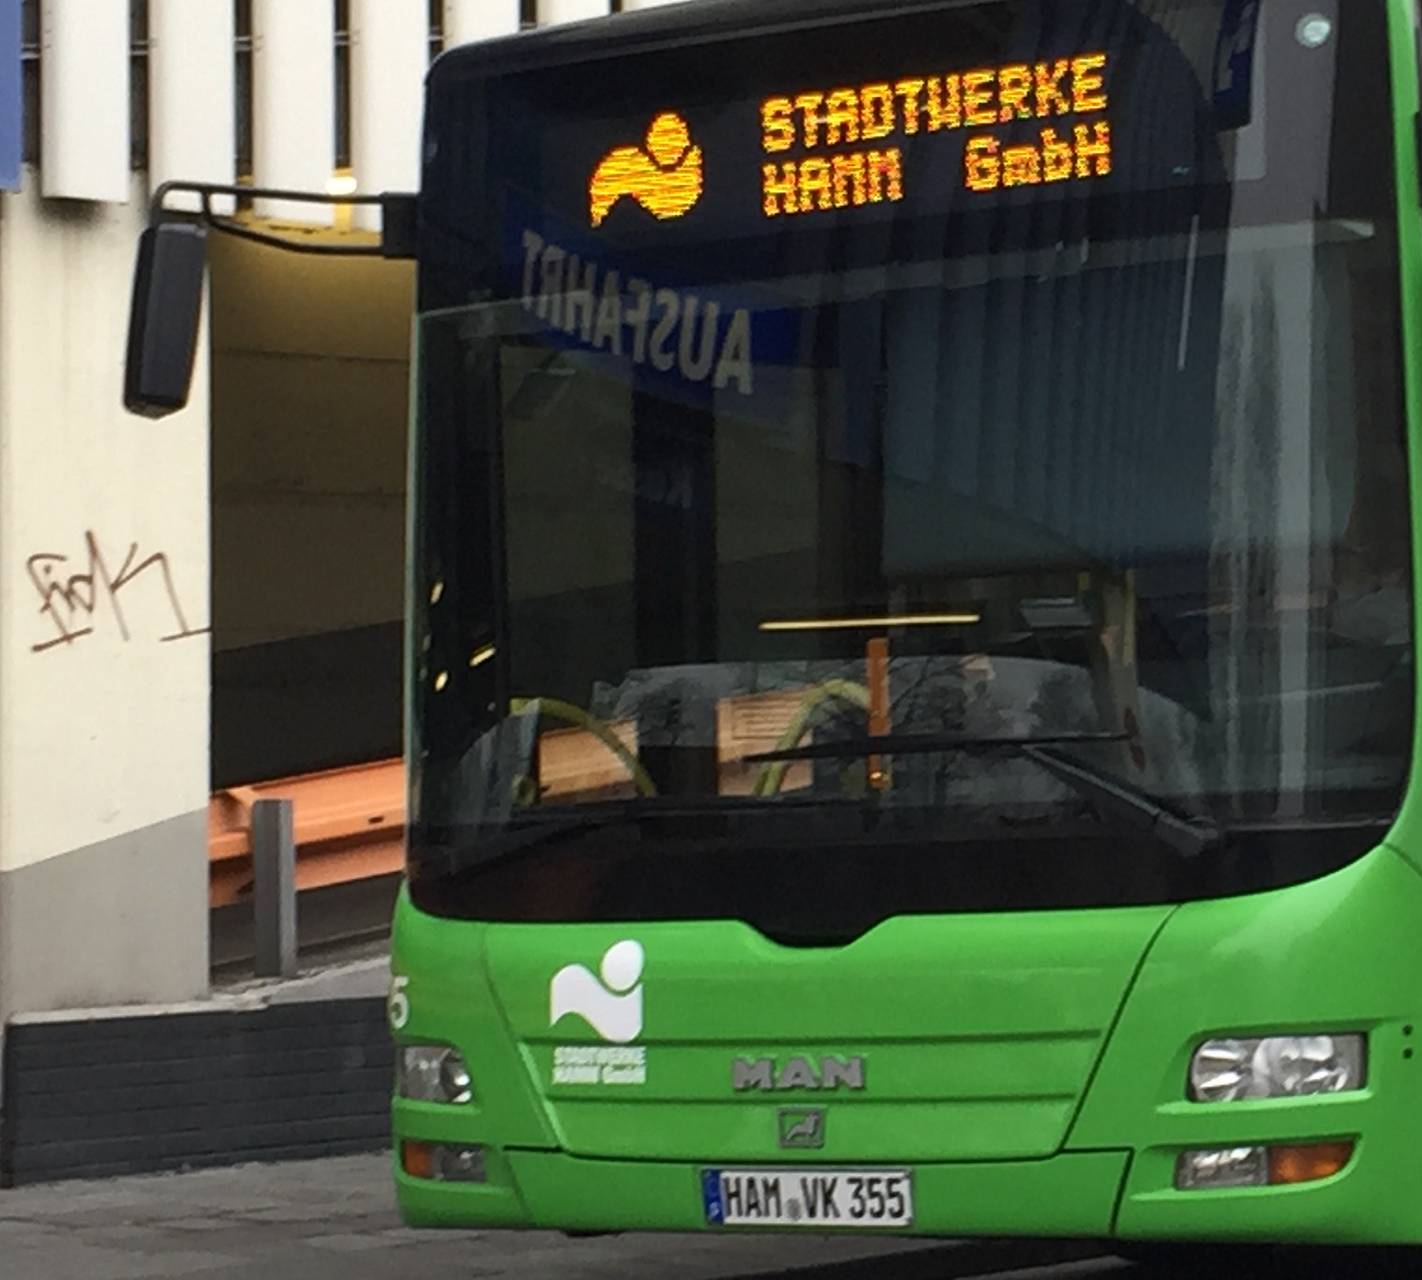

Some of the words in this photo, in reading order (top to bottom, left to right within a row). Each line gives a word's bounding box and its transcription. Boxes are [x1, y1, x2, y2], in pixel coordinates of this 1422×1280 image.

[760, 53, 1108, 154] STADTWERKE
[762, 147, 904, 217] HAMM
[965, 121, 1111, 192] GmbH
[733, 1056, 865, 1090] MAN
[725, 1177, 782, 1217] HAM
[801, 1177, 840, 1218] VK
[846, 1177, 905, 1218] 355
